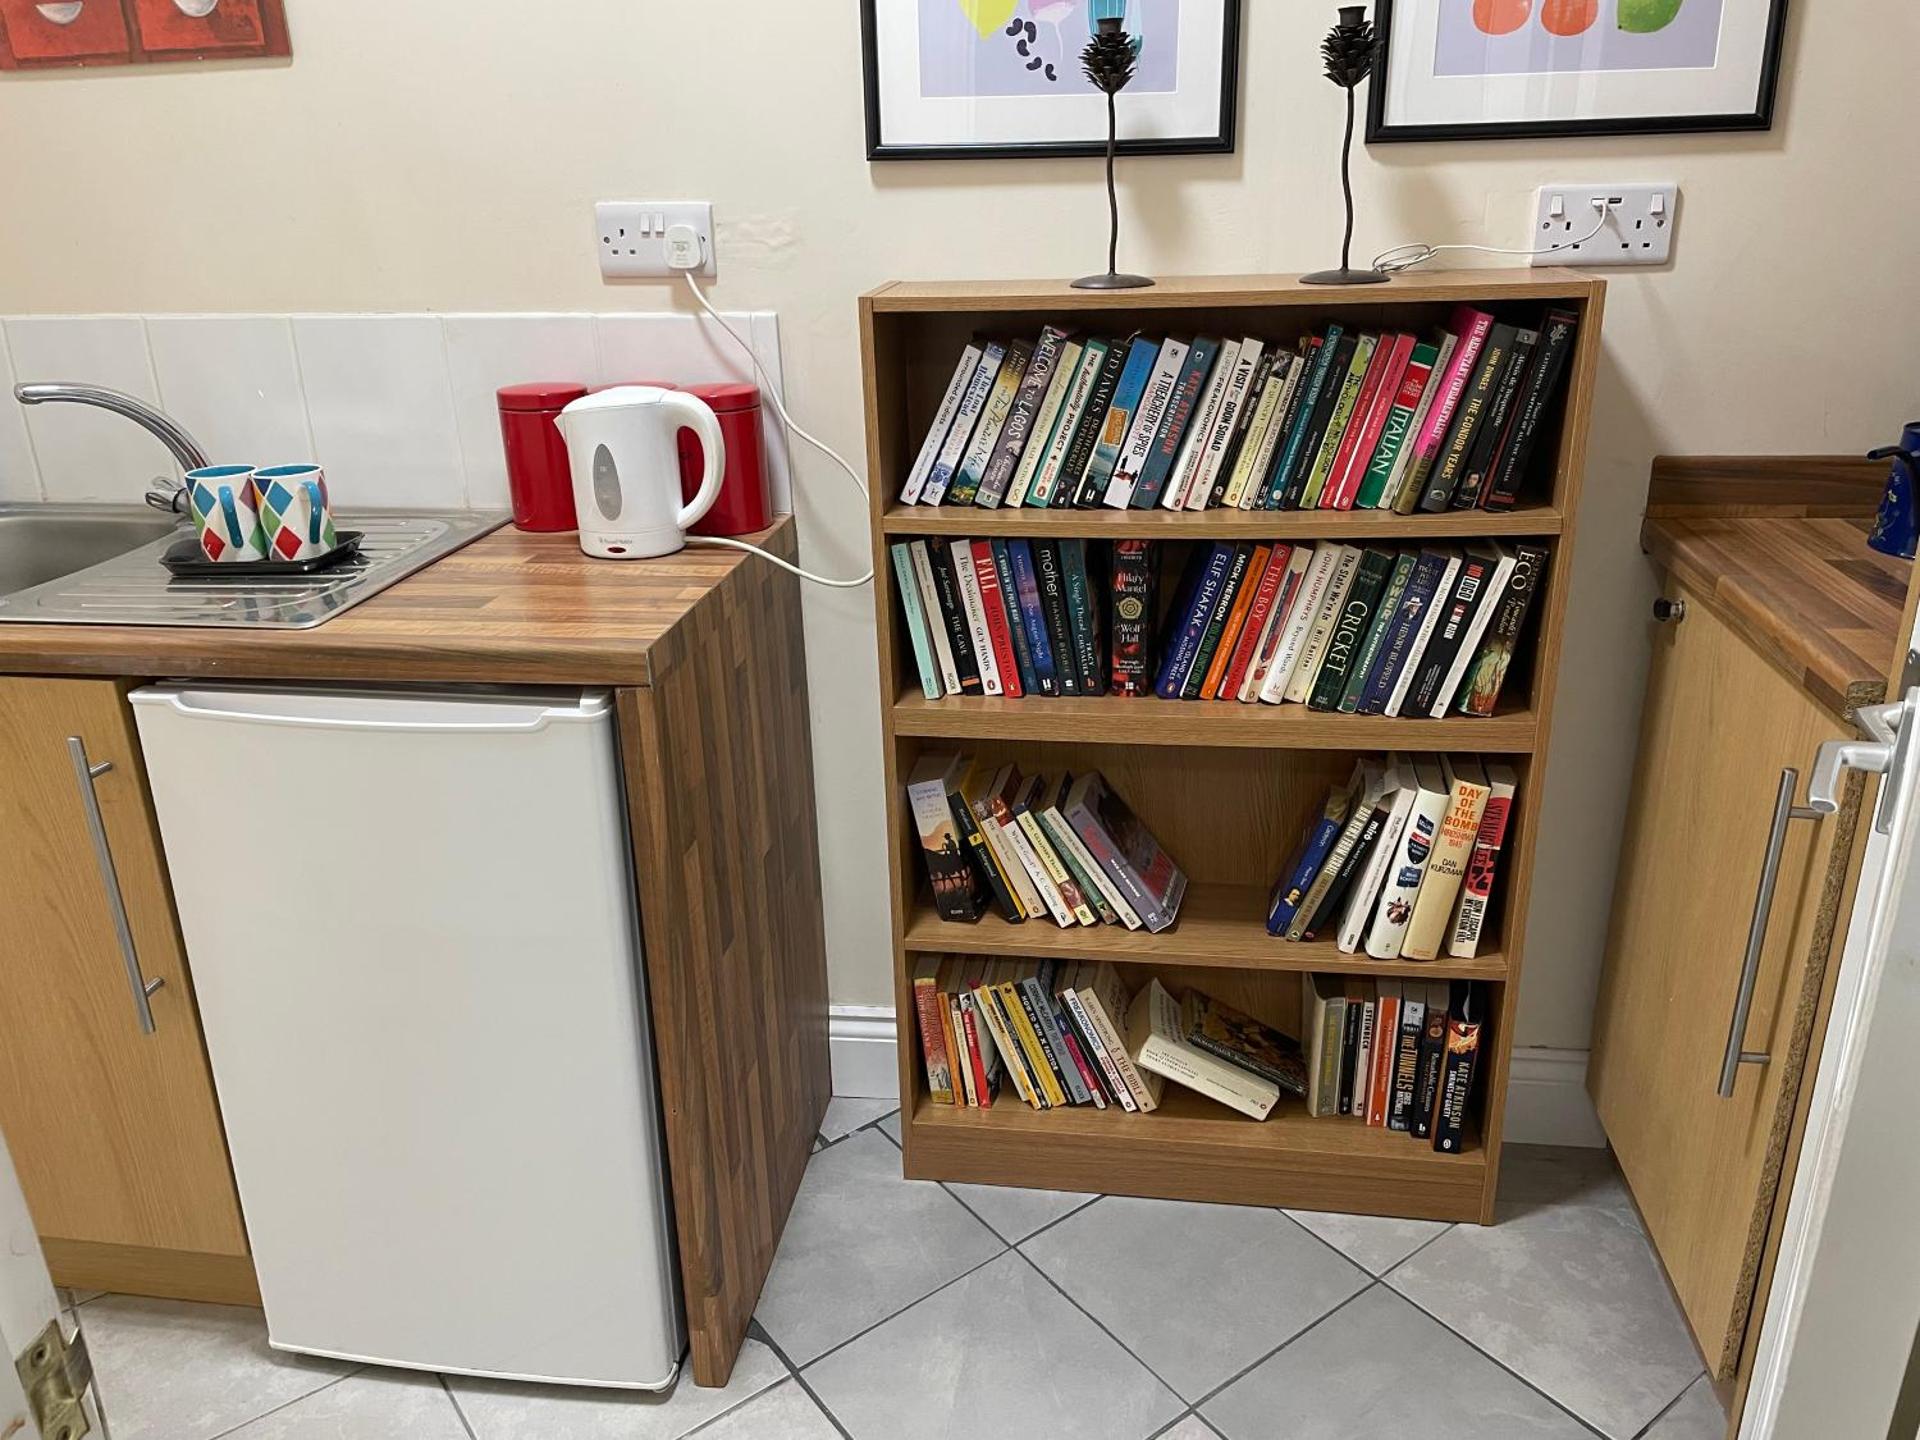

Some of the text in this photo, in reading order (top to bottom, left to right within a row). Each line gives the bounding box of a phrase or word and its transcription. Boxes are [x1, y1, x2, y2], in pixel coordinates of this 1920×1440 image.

[1087, 351, 1098, 367] THE
[1233, 358, 1252, 390] A VISIT
[1488, 347, 1501, 364] JOHN
[951, 355, 972, 396] surrounded
[960, 364, 986, 416] Homestead
[969, 374, 992, 414] The Lost
[1005, 331, 1060, 439] WELCOME TO LAGOS
[1089, 371, 1114, 414] JAMES
[1430, 317, 1488, 440] THE RELUCTANT FUNDAMENTALIST
[945, 393, 956, 405] by
[1144, 379, 1170, 425] TREACHERY
[1159, 381, 1186, 438] TRANSCRIPTION
[1161, 369, 1202, 454] KATE ATKINSON
[1220, 399, 1237, 424] GOON
[1055, 412, 1075, 451] PROJECT
[1082, 414, 1091, 426] TO
[1142, 423, 1151, 433] OF
[1210, 423, 1228, 451] SQUAD
[1440, 396, 1482, 480] THE CONDOR YEARS
[1072, 417, 1098, 475] DEATH COMES
[1131, 432, 1150, 457] SPIES
[1371, 407, 1409, 475] ITALIAN
[958, 555, 970, 572] The
[976, 557, 998, 593] FALL
[1039, 548, 1061, 598] mother
[1209, 552, 1226, 577] ELIF
[1262, 563, 1280, 593] THIS
[1507, 550, 1537, 592] ECO
[1190, 577, 1217, 627] SHAFAK
[1214, 553, 1245, 621] MICK HERRON
[1299, 550, 1333, 621] JOHN HUMPHRYS
[1320, 553, 1354, 621] The State We're In
[1379, 561, 1411, 621] GOWER
[1455, 574, 1479, 603] LOGO
[1070, 581, 1082, 604] Single
[1076, 606, 1087, 631] Thread
[1251, 595, 1269, 620] BOY
[975, 626, 986, 644] GUY
[1120, 624, 1140, 633] Wolf
[1121, 634, 1139, 643] Hall
[1313, 628, 1324, 642] Will
[1323, 597, 1370, 675] CRICKET
[1376, 621, 1385, 633] THE
[978, 644, 992, 671] HANDS
[1077, 633, 1089, 675] CHEVALIER
[1085, 641, 1094, 665] TRACY
[1168, 635, 1190, 679] MISSING TREES
[1178, 649, 1191, 672] ISLAND
[1278, 623, 1304, 675] Beyond Words
[1376, 622, 1410, 689] HENRY BLOFELD
[1459, 786, 1482, 799] DAY
[1460, 798, 1475, 808] OF
[1444, 816, 1478, 831] BOMB
[1455, 807, 1476, 819] THE
[1431, 864, 1463, 876] KURZMAN
[1442, 858, 1457, 868] DAN
[1020, 995, 1031, 1011] HOW
[1043, 1045, 1058, 1071] FACTOR
[1069, 996, 1101, 1050] FREAKONOMICS
[1361, 1008, 1372, 1050] STEINBECK
[1115, 1055, 1144, 1097] THE BIBLE
[1395, 1034, 1417, 1090] THE TUNNELS
[1446, 1069, 1457, 1092] SHRINES
[1448, 1061, 1469, 1129] KATE ATKINSON
